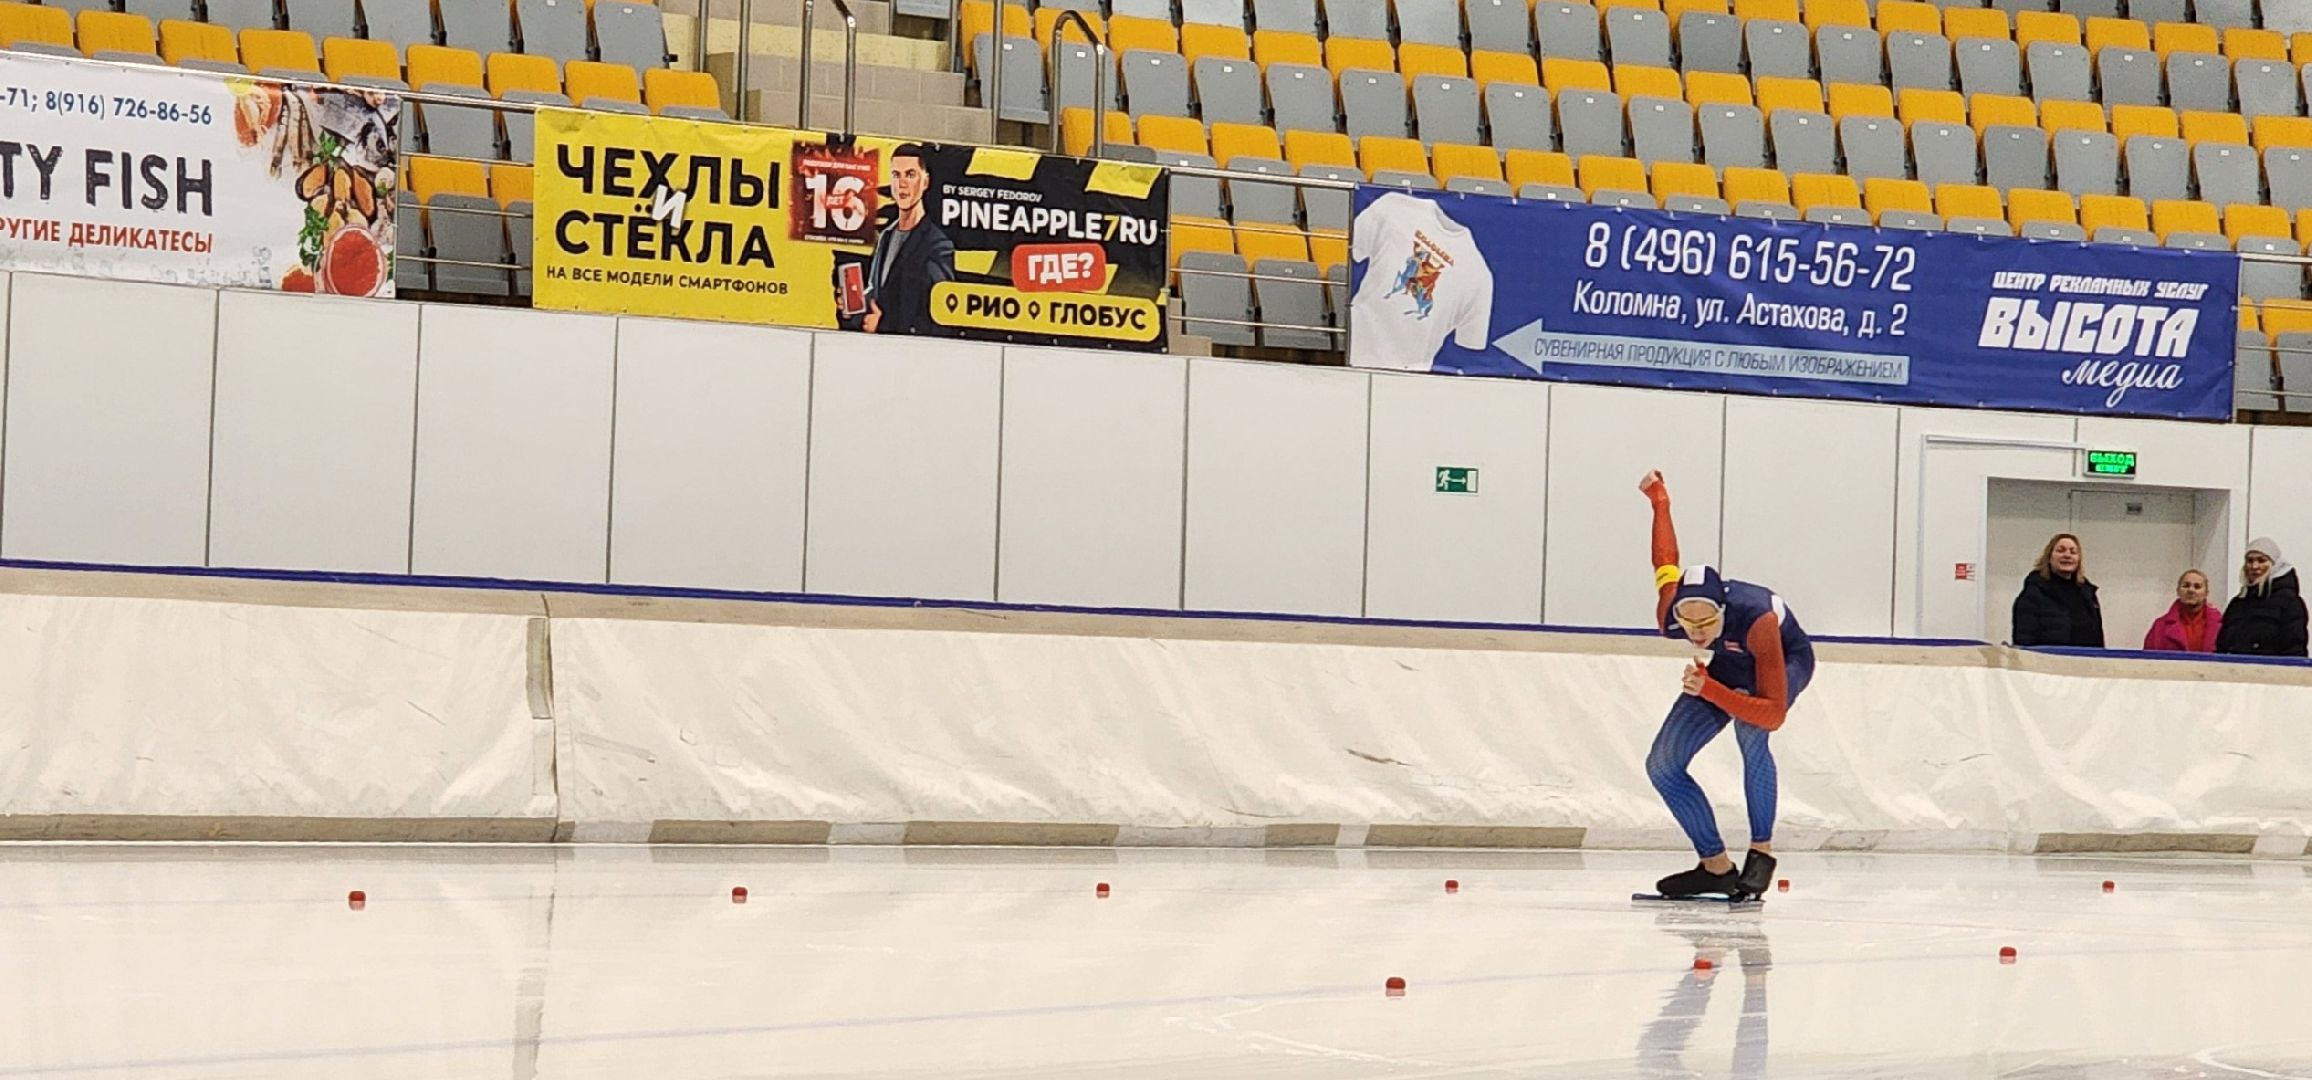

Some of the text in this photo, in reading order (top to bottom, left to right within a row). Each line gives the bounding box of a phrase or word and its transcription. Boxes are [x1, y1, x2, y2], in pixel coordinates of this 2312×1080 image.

[45, 90, 105, 120] 8(916)
[113, 97, 212, 125] 726-86-56
[0, 141, 213, 216] TY FISH
[556, 144, 780, 209] ЧЕХЛЫ
[942, 183, 1043, 203] BY SERGEY FEDOROV
[651, 184, 688, 230] И
[804, 173, 866, 232] 16
[941, 198, 1157, 246] PINEAPPLE7RU
[68, 222, 213, 253] ДЕЛИКАТЕСЫ
[555, 204, 775, 269] СТЁКЛА
[1586, 222, 1915, 291] 8 (496) 615-56-72
[547, 265, 789, 296] НА ВСЕ МОДЕЛИ СМАРТФОНОВ
[1027, 252, 1094, 285] ГДЕ?
[1993, 272, 2208, 300] ЦЕНТР РЕКЛАМНЫХ УСЛУГ
[966, 294, 1147, 330] РИО ГЛОБУС
[1574, 281, 1908, 339] Коломна, ул. Астахова, д. 2
[1979, 297, 2199, 357] ВЫСОТА
[1534, 337, 1903, 380] СУВЕНИРНАЯ ПРОДУКЦИЯ С ЛЮБЫМ ИЗОБРАЖЕНИЕМ
[2062, 359, 2184, 408] медиа
[2090, 452, 2135, 467] ВЫХОД
